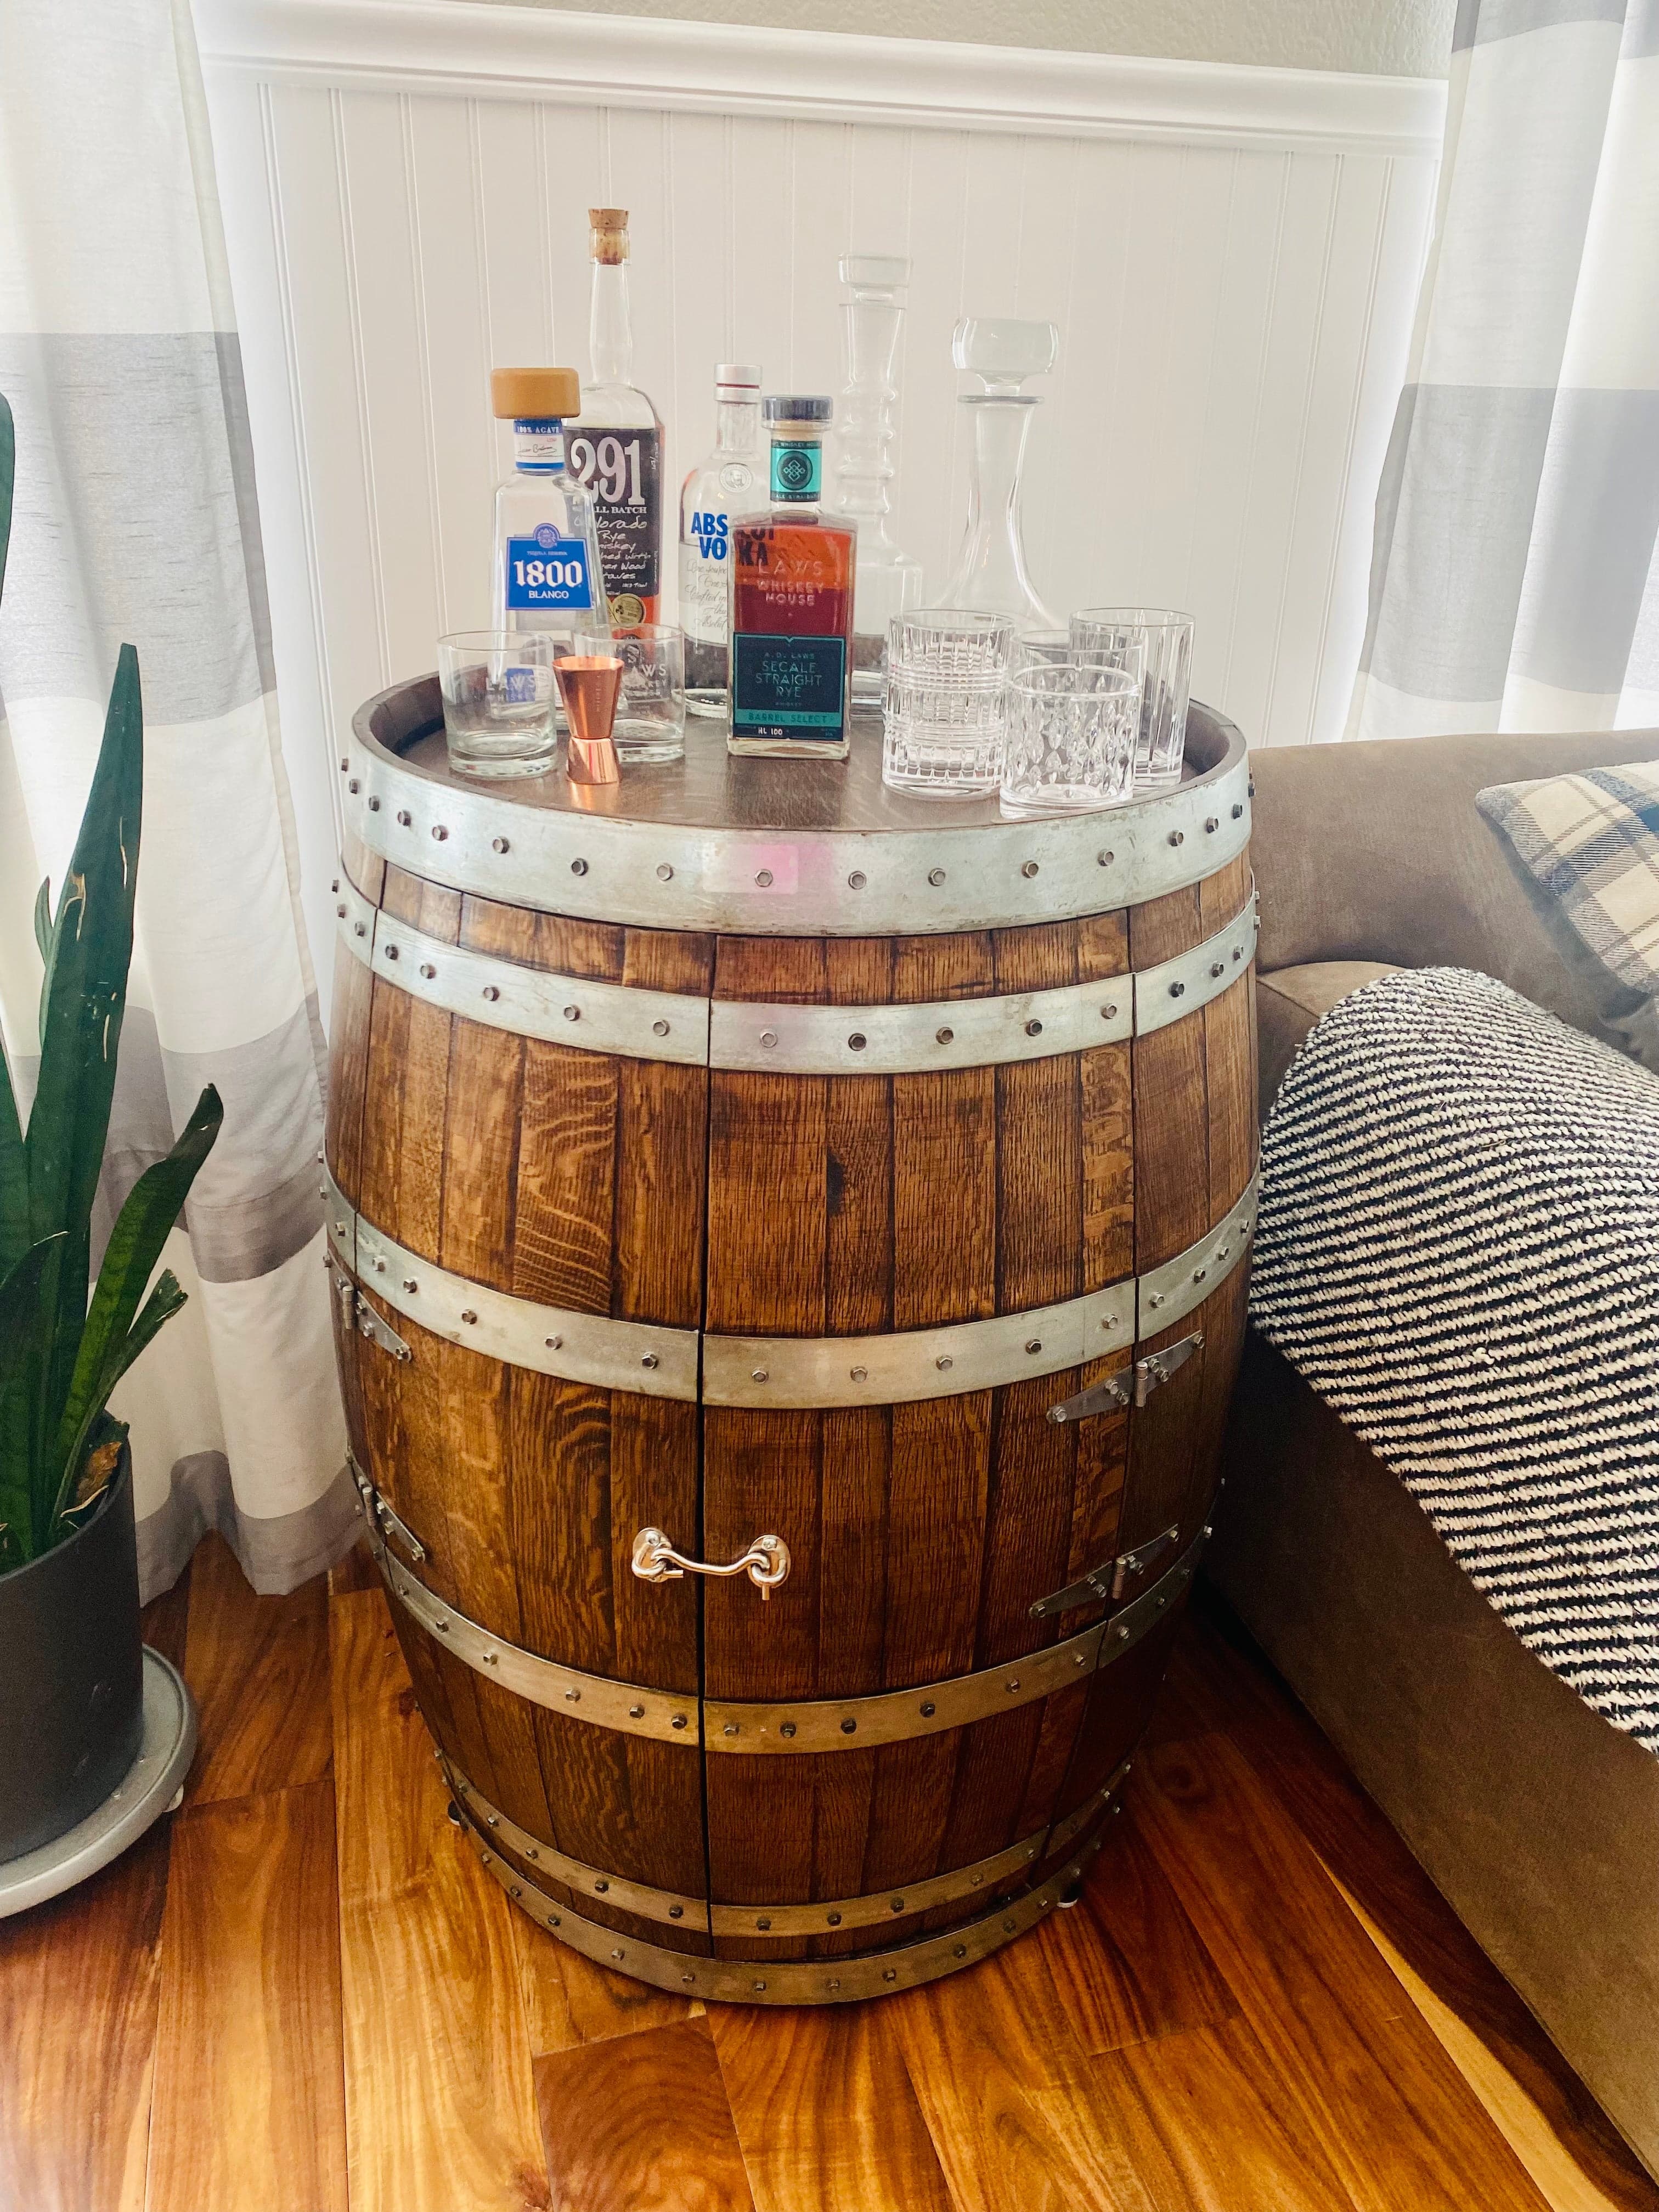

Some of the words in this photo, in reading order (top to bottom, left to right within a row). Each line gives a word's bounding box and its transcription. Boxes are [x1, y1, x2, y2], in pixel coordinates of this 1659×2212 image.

[570, 436, 646, 506] 291
[596, 515, 647, 529] lorado
[513, 560, 583, 588] 1800
[758, 558, 823, 577] LAWS
[757, 579, 823, 594] WHISKEY
[528, 590, 570, 599] BLANCO
[765, 592, 815, 606] HOUSE
[762, 660, 817, 673] SECALE
[755, 673, 822, 686] STRAIGHT
[776, 686, 802, 698] RYE
[748, 712, 786, 723] BARREL
[791, 714, 828, 724] SELECT
[770, 727, 783, 736] 100
